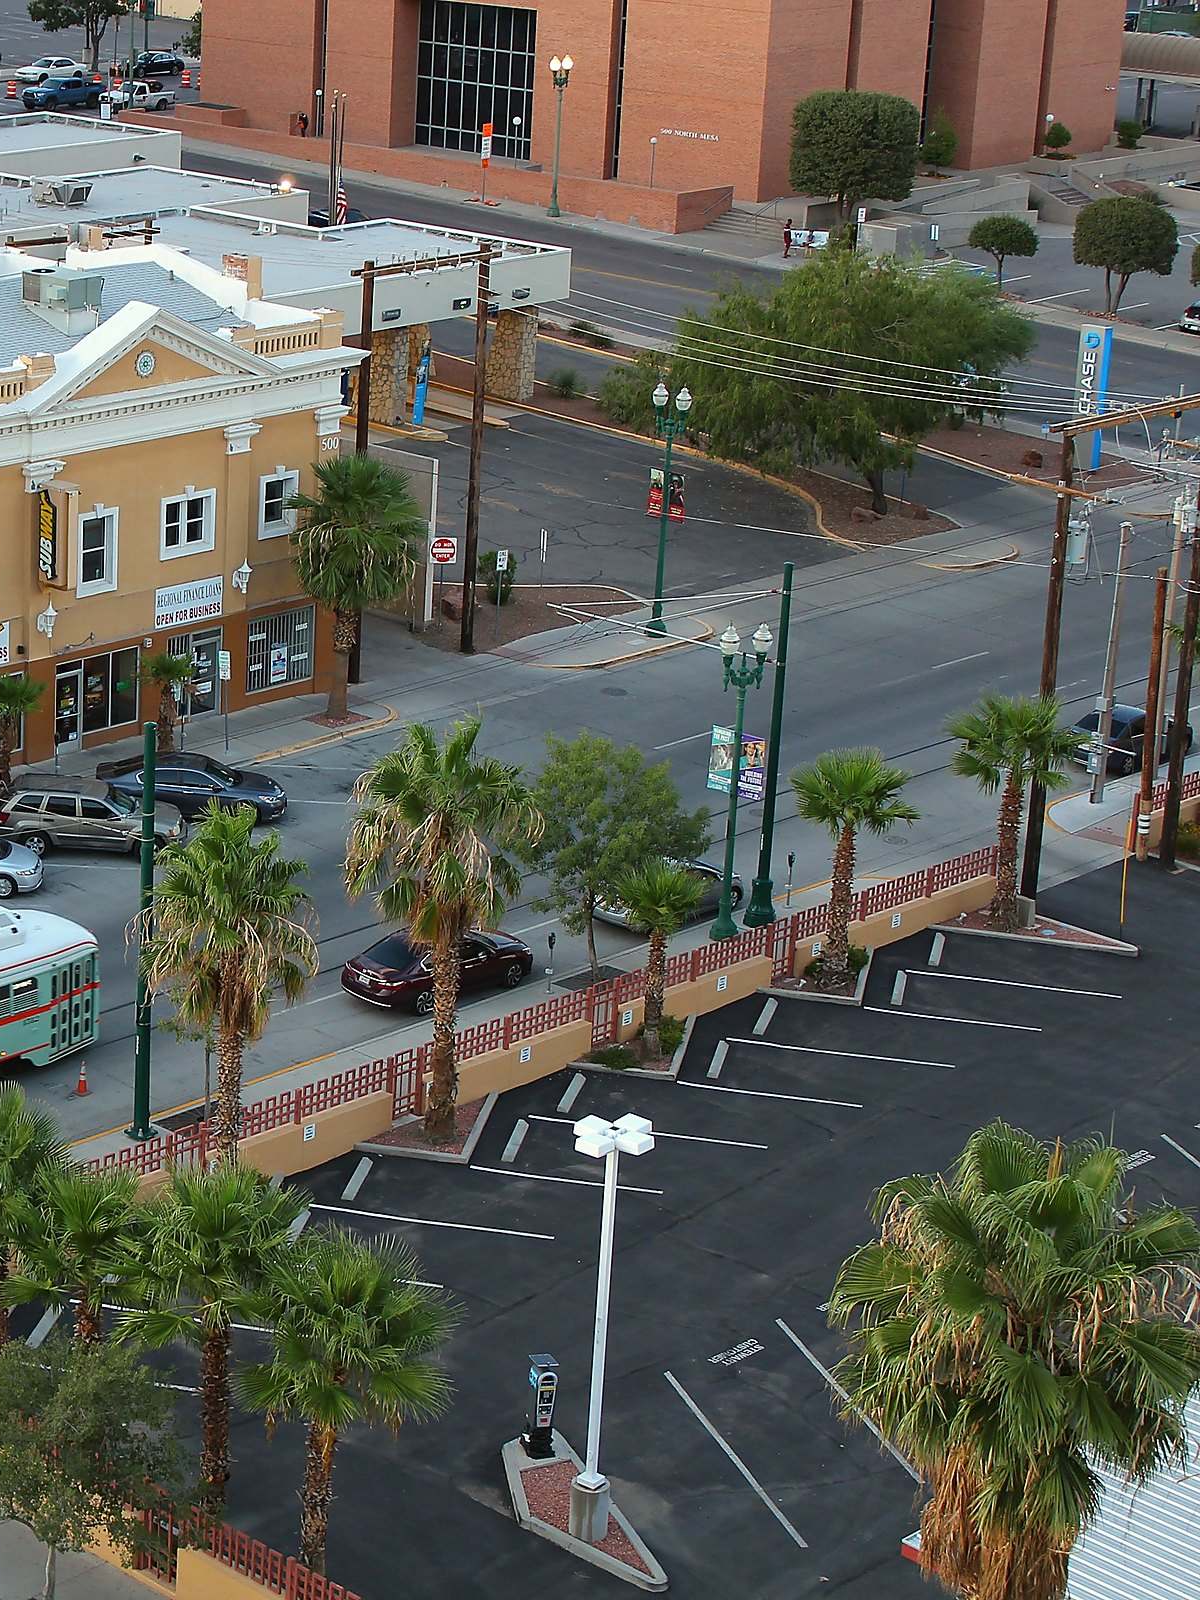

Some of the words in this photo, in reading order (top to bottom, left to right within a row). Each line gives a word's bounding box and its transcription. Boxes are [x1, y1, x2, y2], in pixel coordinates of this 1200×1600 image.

[674, 129, 698, 139] NORTH
[700, 133, 719, 142] MESA
[1078, 351, 1097, 415] CHASE
[322, 436, 339, 450] 500
[38, 489, 57, 580] SUBWAY
[156, 590, 183, 608] REGIONAL
[184, 586, 204, 603] FINANCE
[206, 583, 222, 598] LOANS
[156, 612, 174, 626] OPEN
[176, 609, 188, 622] FOR
[189, 602, 221, 619] BUSINESS
[707, 1338, 759, 1364] CUSTOMER
[721, 1344, 765, 1367] STEWART
